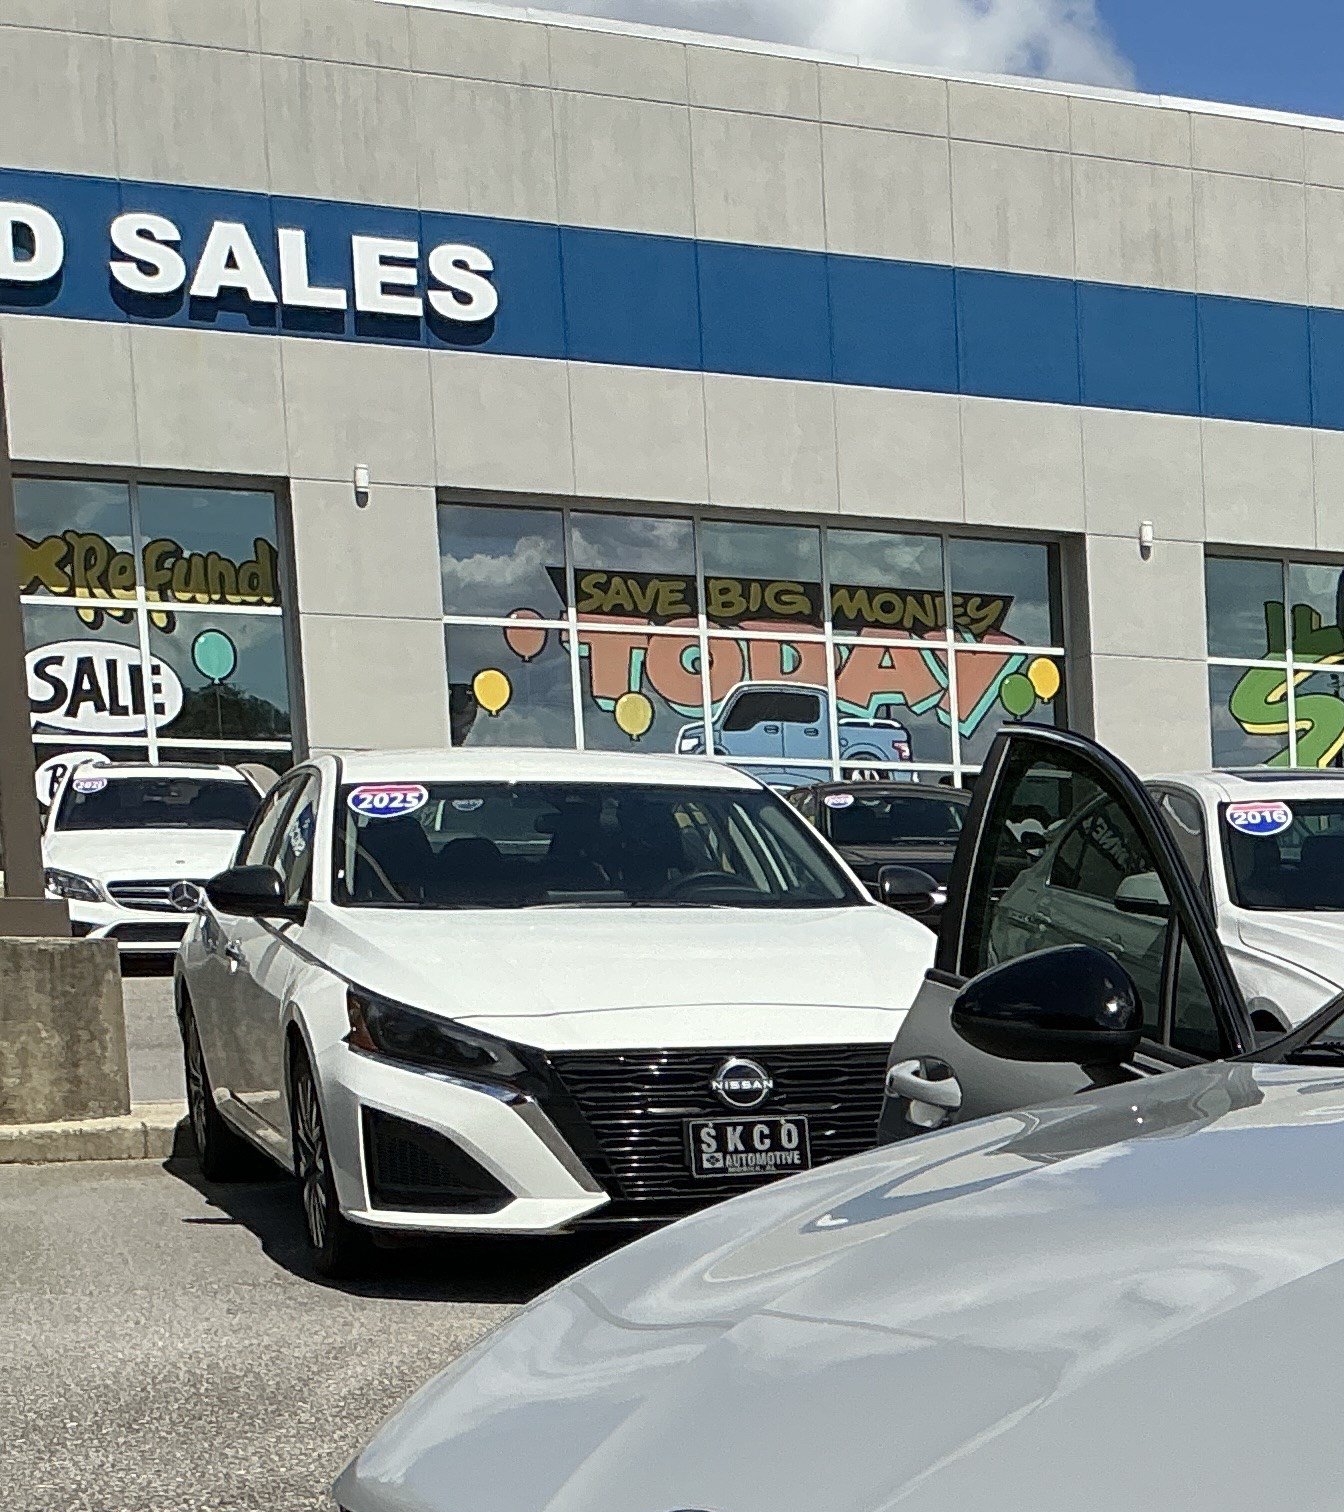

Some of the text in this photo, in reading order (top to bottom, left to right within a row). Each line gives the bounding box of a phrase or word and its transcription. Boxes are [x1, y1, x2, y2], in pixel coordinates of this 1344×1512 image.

[108, 213, 499, 323] SALES
[578, 573, 1004, 633] SAVE BIG MONEY
[30, 655, 166, 718] SALE
[564, 612, 1025, 738] TODAY
[358, 792, 420, 809] 2025
[1233, 809, 1287, 825] 2016
[712, 1079, 774, 1091] NISSAN
[700, 1122, 799, 1153] SKCO
[725, 1151, 801, 1167] AUTOMOTIVE
